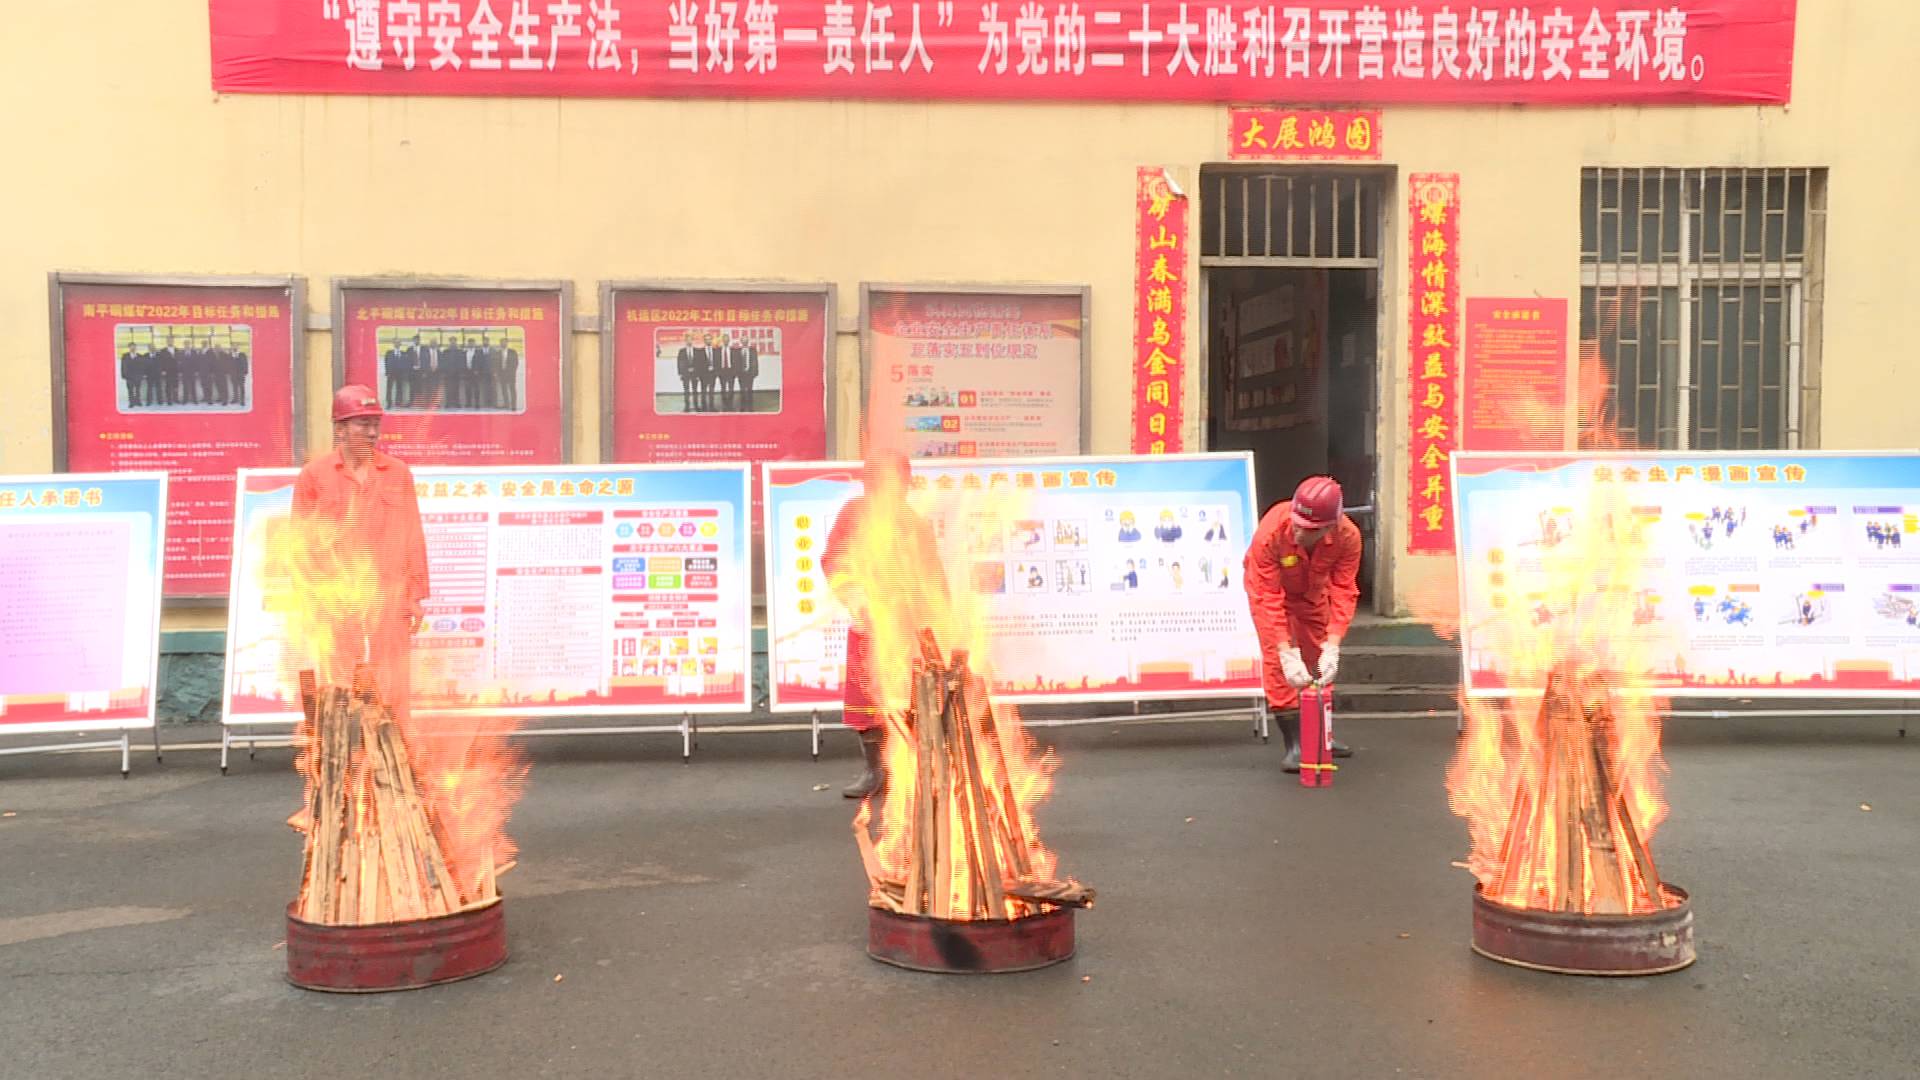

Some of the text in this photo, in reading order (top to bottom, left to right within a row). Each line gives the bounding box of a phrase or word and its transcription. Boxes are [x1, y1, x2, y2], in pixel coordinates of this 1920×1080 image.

[1241, 115, 1371, 151] 大展鸿图
[890, 365, 904, 383] 5
[960, 394, 975, 404] 01
[911, 469, 1117, 490] 安全生产漫画宣传
[1592, 465, 1808, 483] 安全生产漫画宣传
[502, 478, 635, 496] 安全是生命之源
